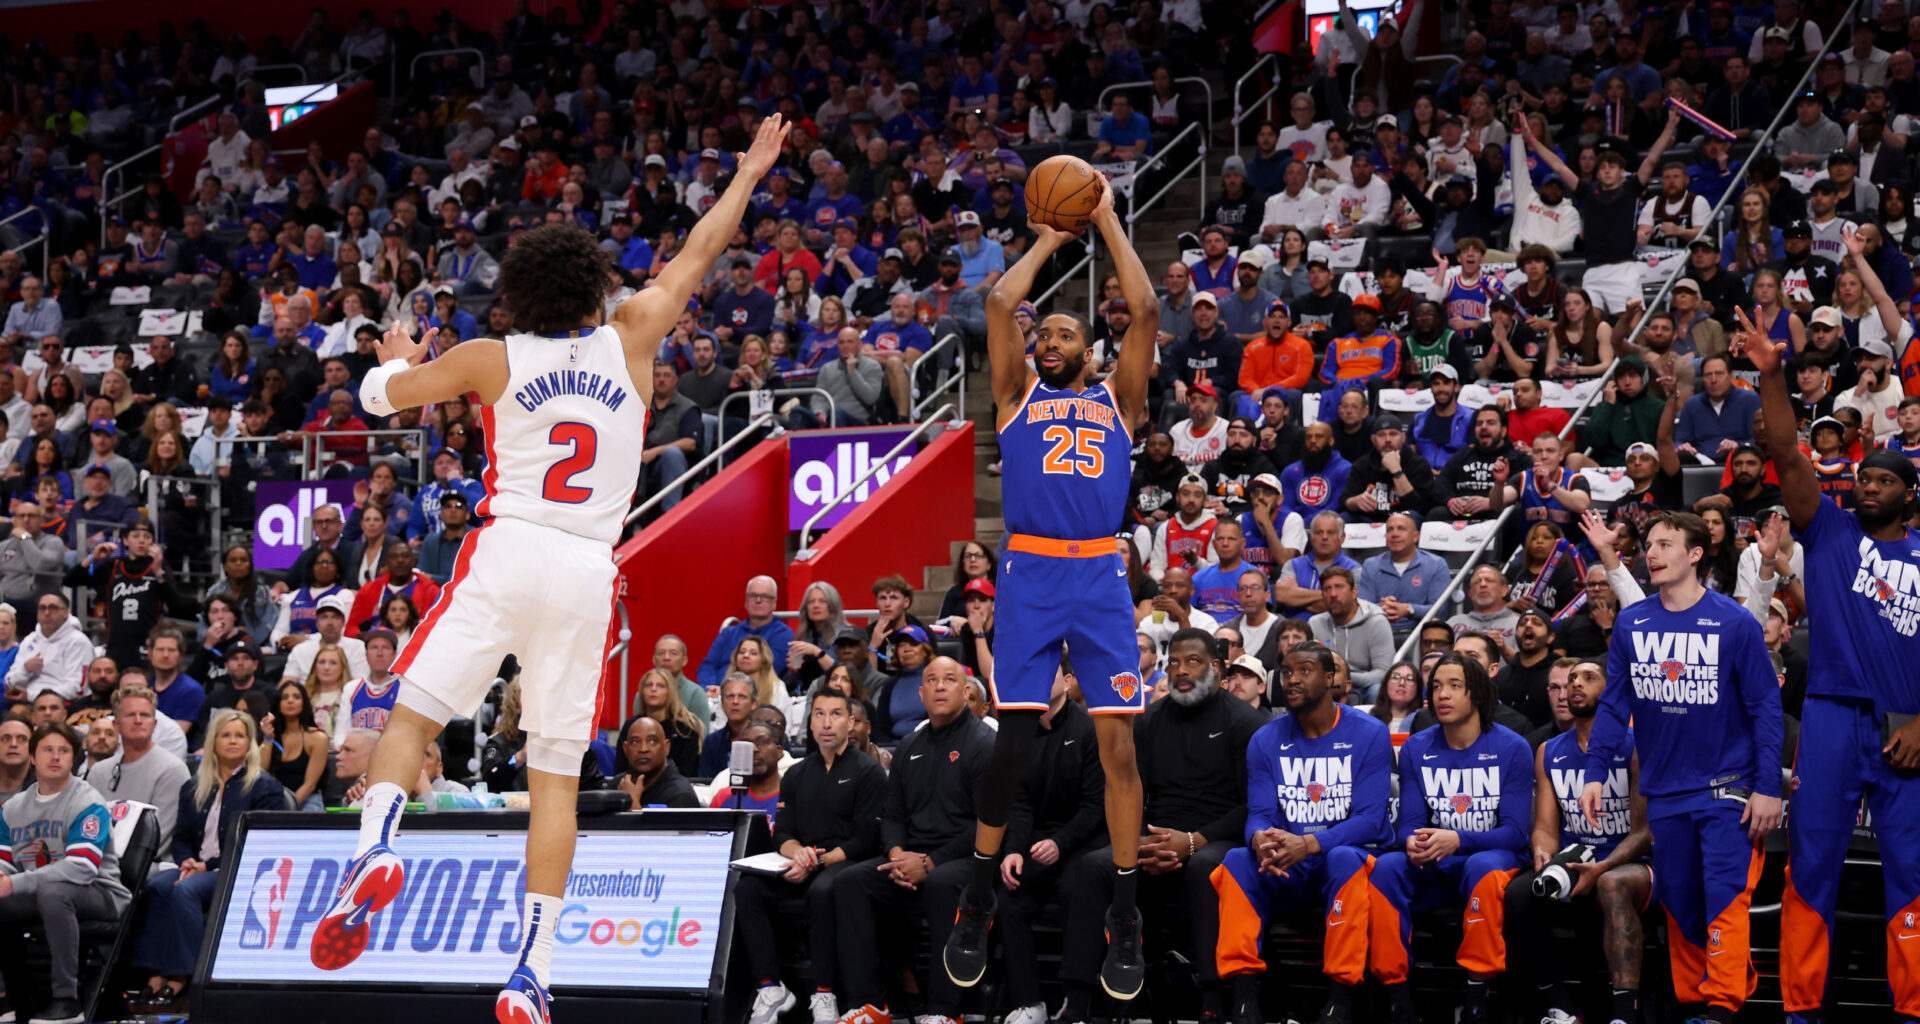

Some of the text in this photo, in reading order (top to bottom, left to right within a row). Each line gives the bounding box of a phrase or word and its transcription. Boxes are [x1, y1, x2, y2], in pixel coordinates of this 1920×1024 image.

[1812, 240, 1841, 254] TROIT
[515, 370, 627, 413] CUNNINGHAM
[1026, 397, 1116, 432] NEW YORK
[542, 421, 598, 504] 2
[1043, 425, 1105, 479] 25
[1859, 536, 1920, 598] WIN
[122, 598, 139, 621] 2
[1632, 631, 1720, 665] WIN
[1630, 662, 1718, 680] FOR THE
[1632, 677, 1719, 705] BOROUGHS
[1279, 754, 1352, 787] WIN
[1421, 766, 1500, 797] WIN
[1551, 768, 1630, 799] WN
[1277, 783, 1352, 800] FOR THE
[1425, 796, 1452, 812] OR
[644, 868, 665, 903] by
[244, 929, 264, 946] NBA
[555, 904, 702, 957] Google
